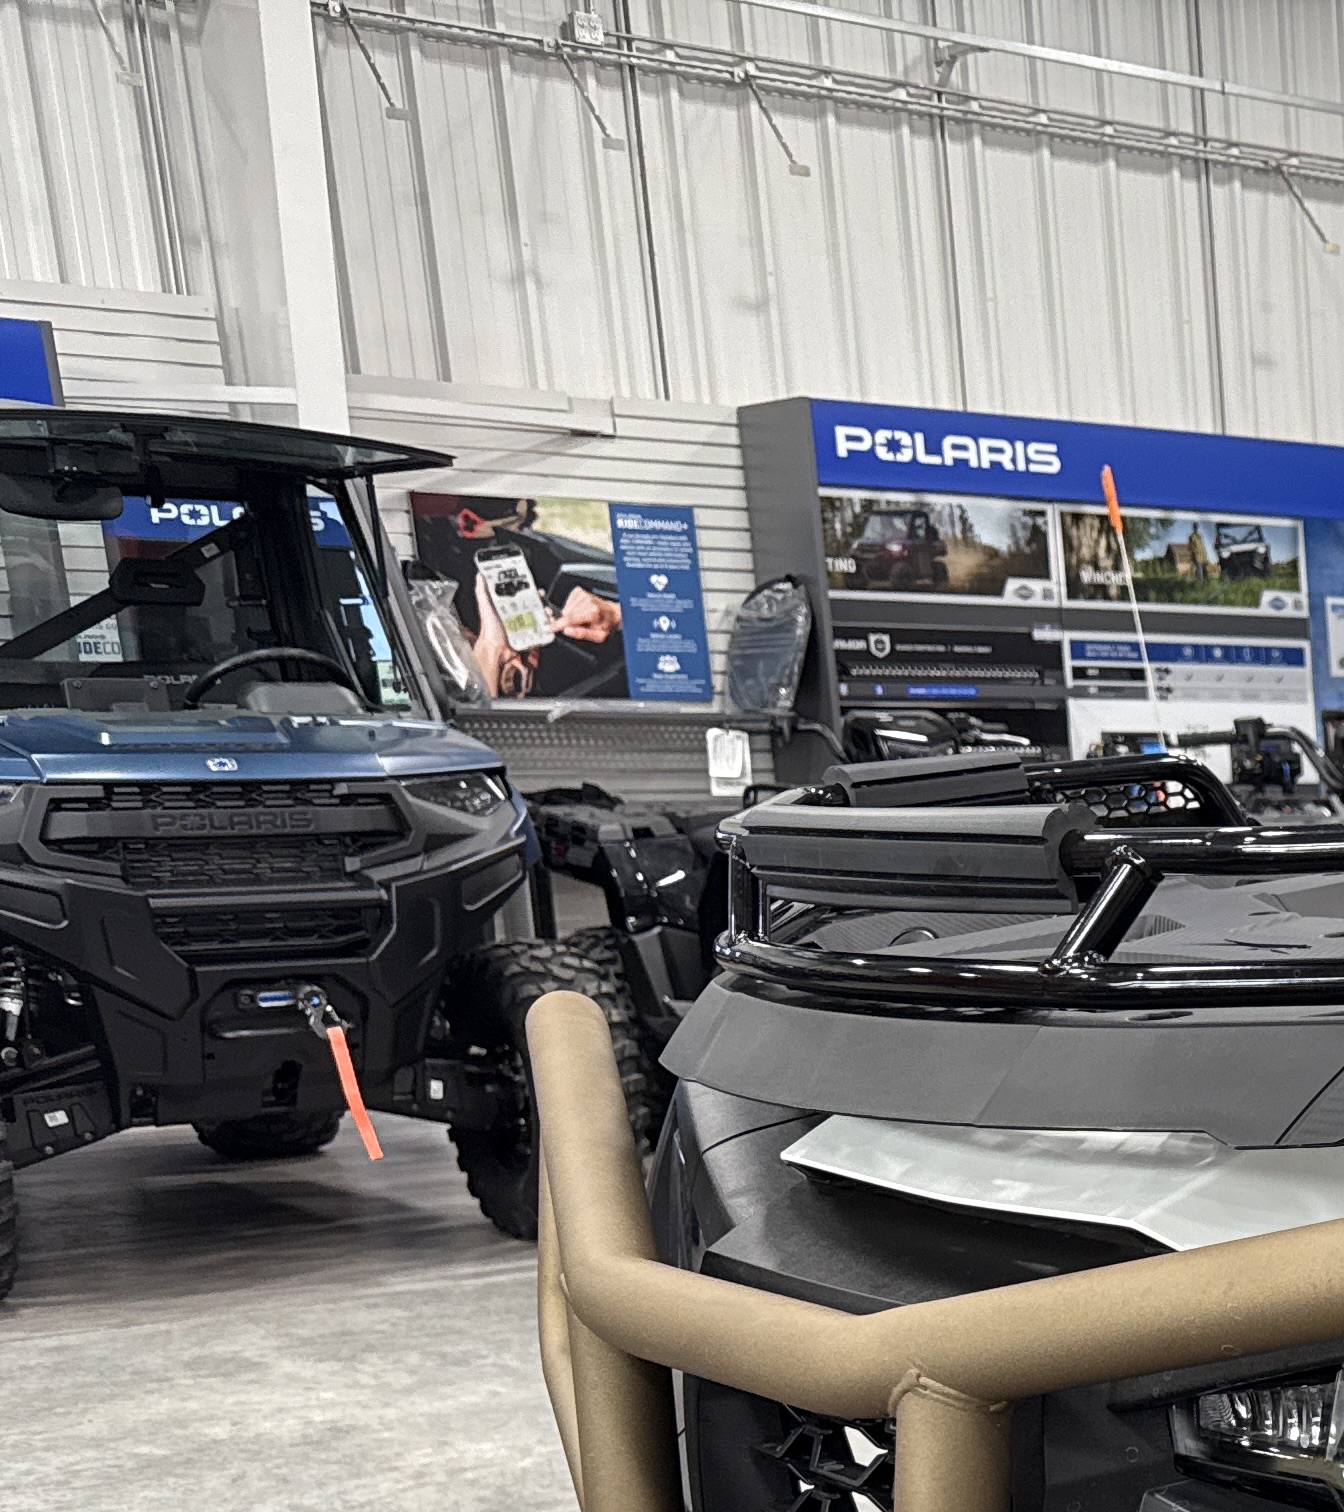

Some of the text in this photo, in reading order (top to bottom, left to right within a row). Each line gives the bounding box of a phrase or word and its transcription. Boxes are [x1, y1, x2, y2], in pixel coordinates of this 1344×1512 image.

[834, 425, 1062, 475] POLARIS
[150, 502, 326, 533] POLS
[824, 556, 857, 574] TING
[151, 810, 315, 833] POLARIS
